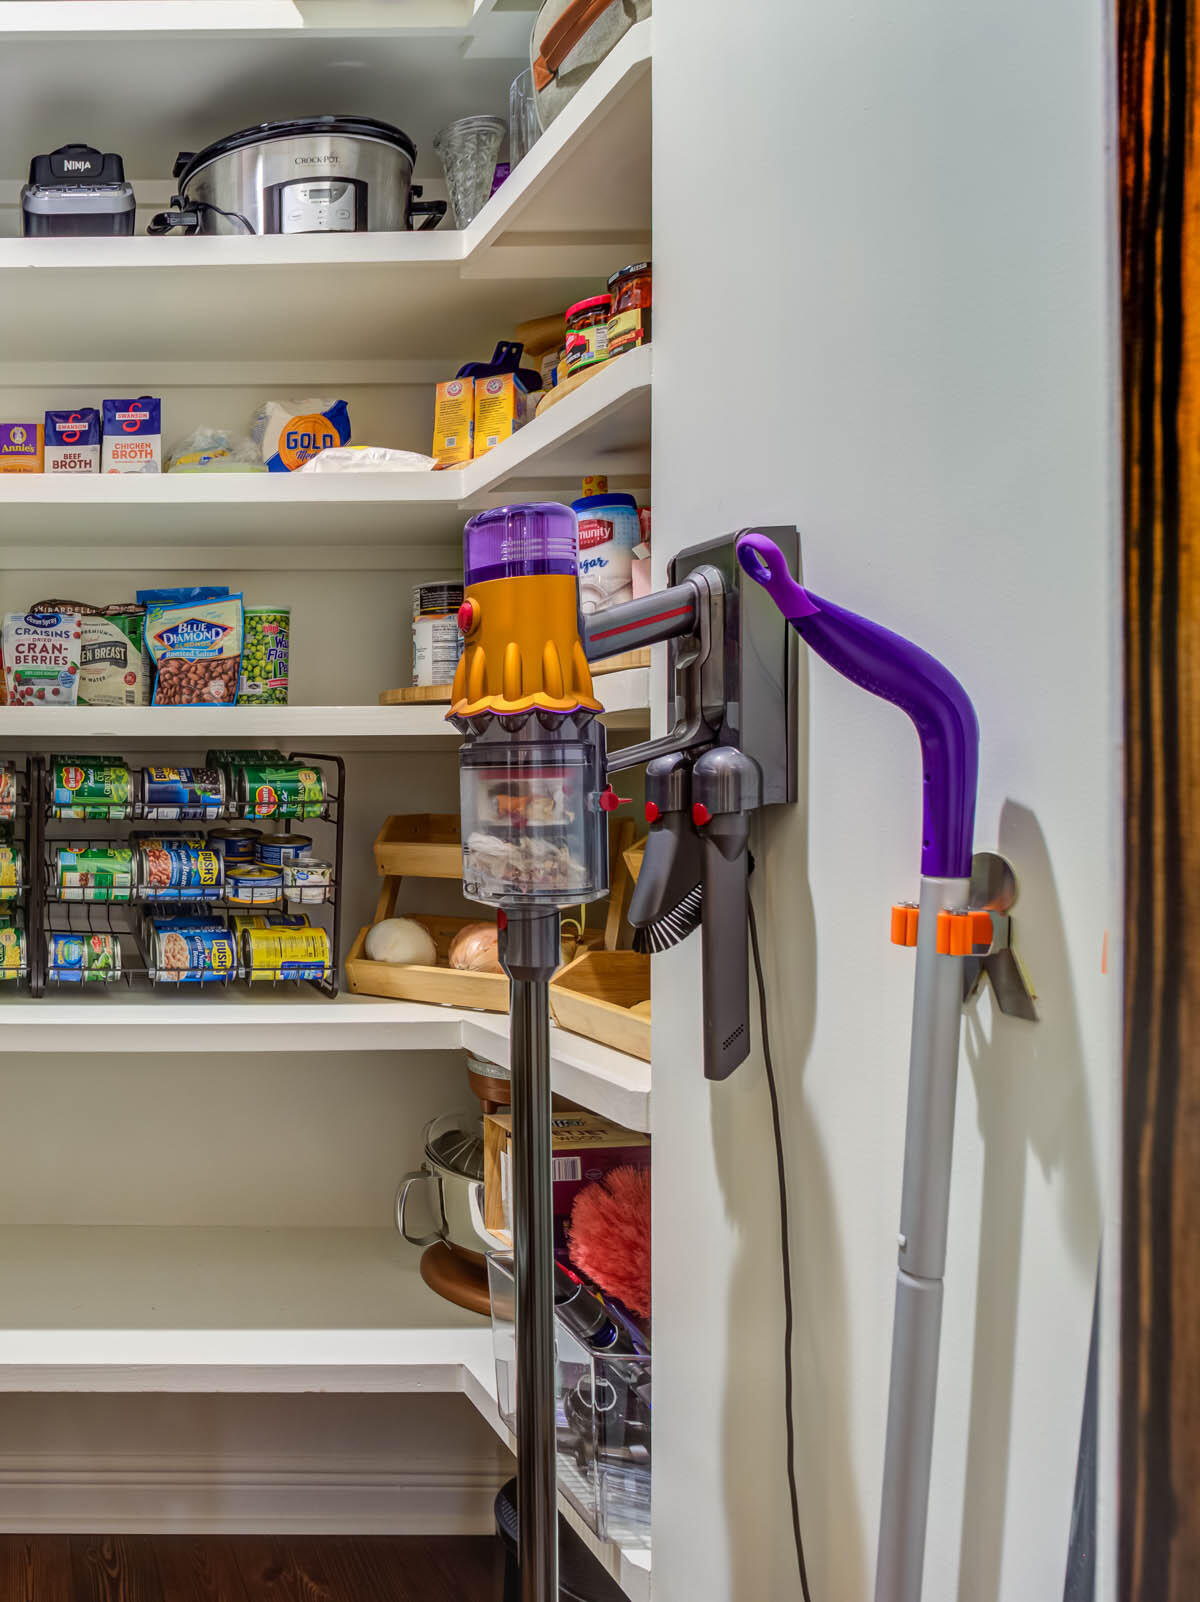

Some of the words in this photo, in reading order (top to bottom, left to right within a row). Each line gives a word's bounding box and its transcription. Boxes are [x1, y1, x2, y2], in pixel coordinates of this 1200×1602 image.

[63, 159, 91, 172] NINJA
[117, 412, 148, 420] SWANSON
[114, 442, 151, 450] CHICKEN
[286, 431, 334, 450] GOLD
[2, 443, 34, 454] Annie's
[112, 449, 153, 460] BROTH
[52, 460, 92, 470] BROTH
[15, 627, 71, 639] CRAISINS
[178, 623, 208, 633] BLUE
[163, 628, 224, 645] DIAMOND
[15, 643, 69, 655] CRAN-
[94, 646, 126, 660] BREAST
[15, 655, 69, 666] BERRIES
[201, 851, 215, 885] BUSH'S
